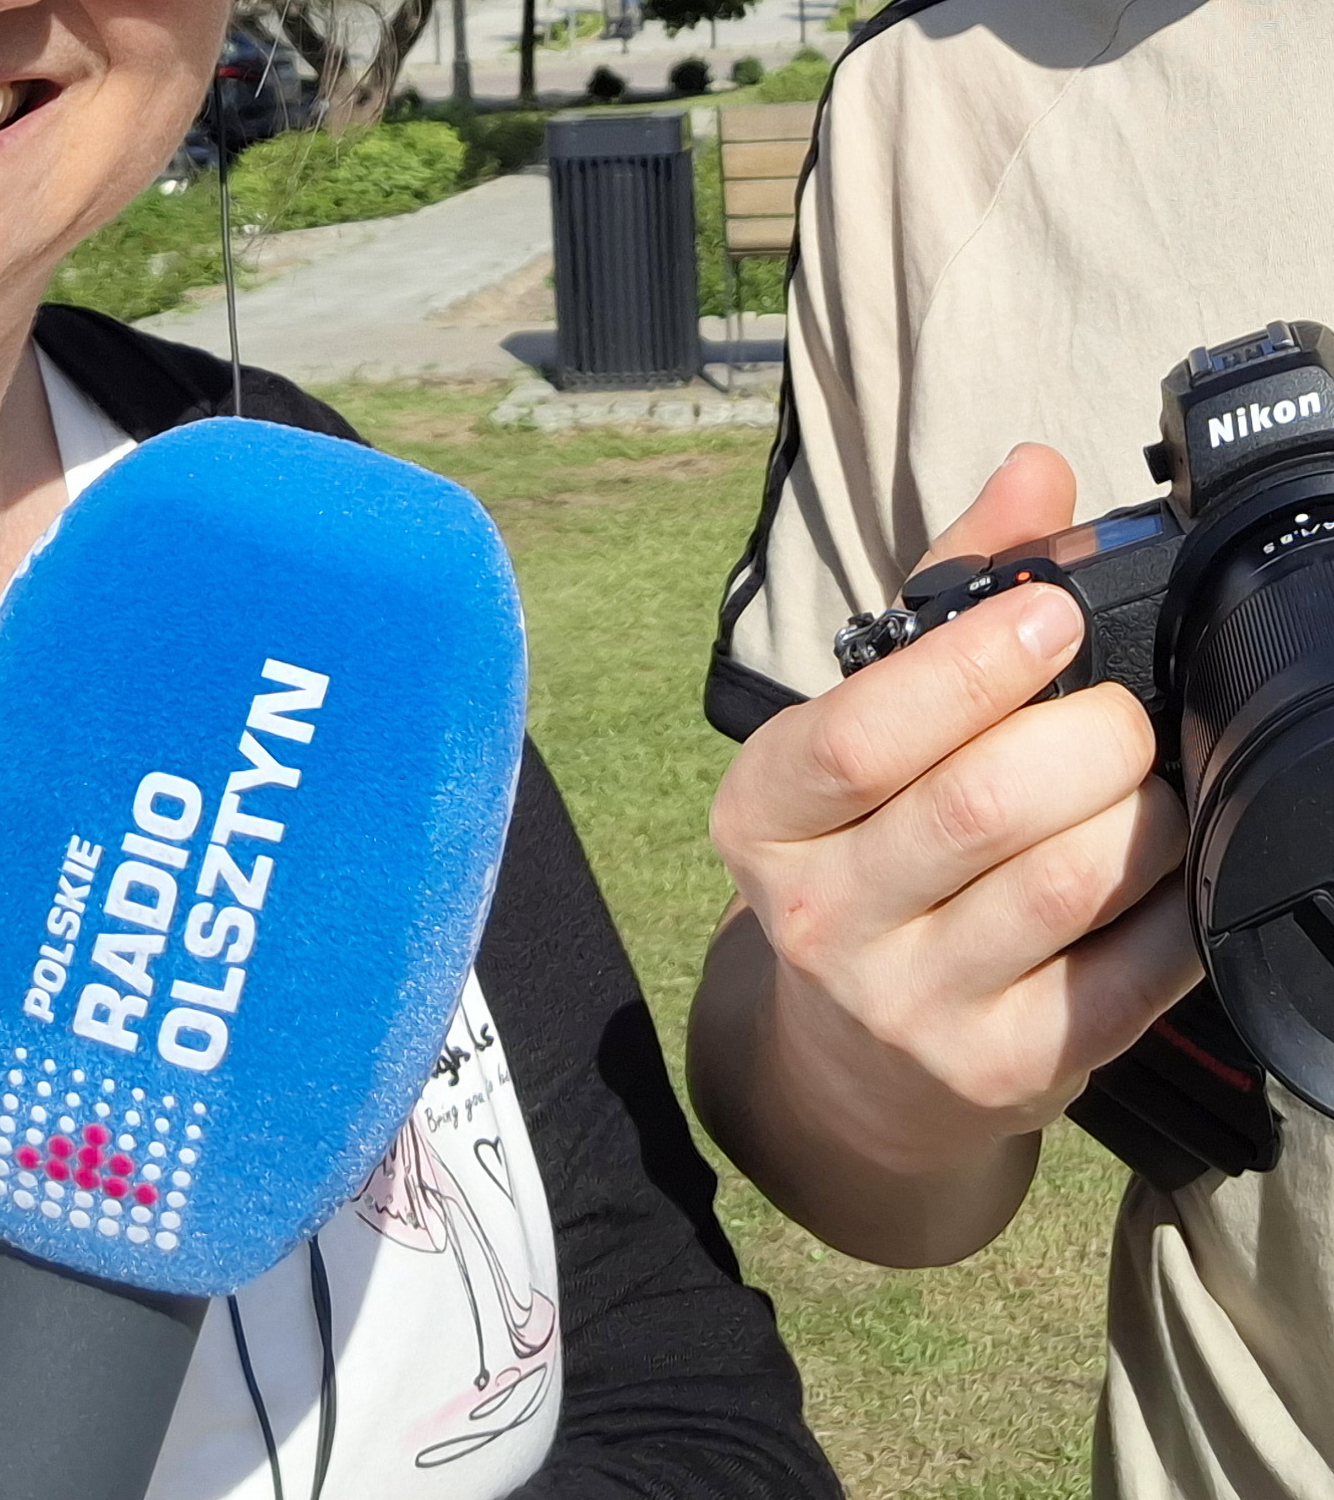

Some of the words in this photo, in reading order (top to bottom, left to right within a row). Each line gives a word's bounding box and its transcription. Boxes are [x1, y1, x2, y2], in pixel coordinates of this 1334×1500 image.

[1208, 391, 1322, 449] Nikon
[23, 833, 102, 1023] POLSKIE
[72, 771, 202, 1053] RADIO
[157, 658, 330, 1073] OLSZTYN
